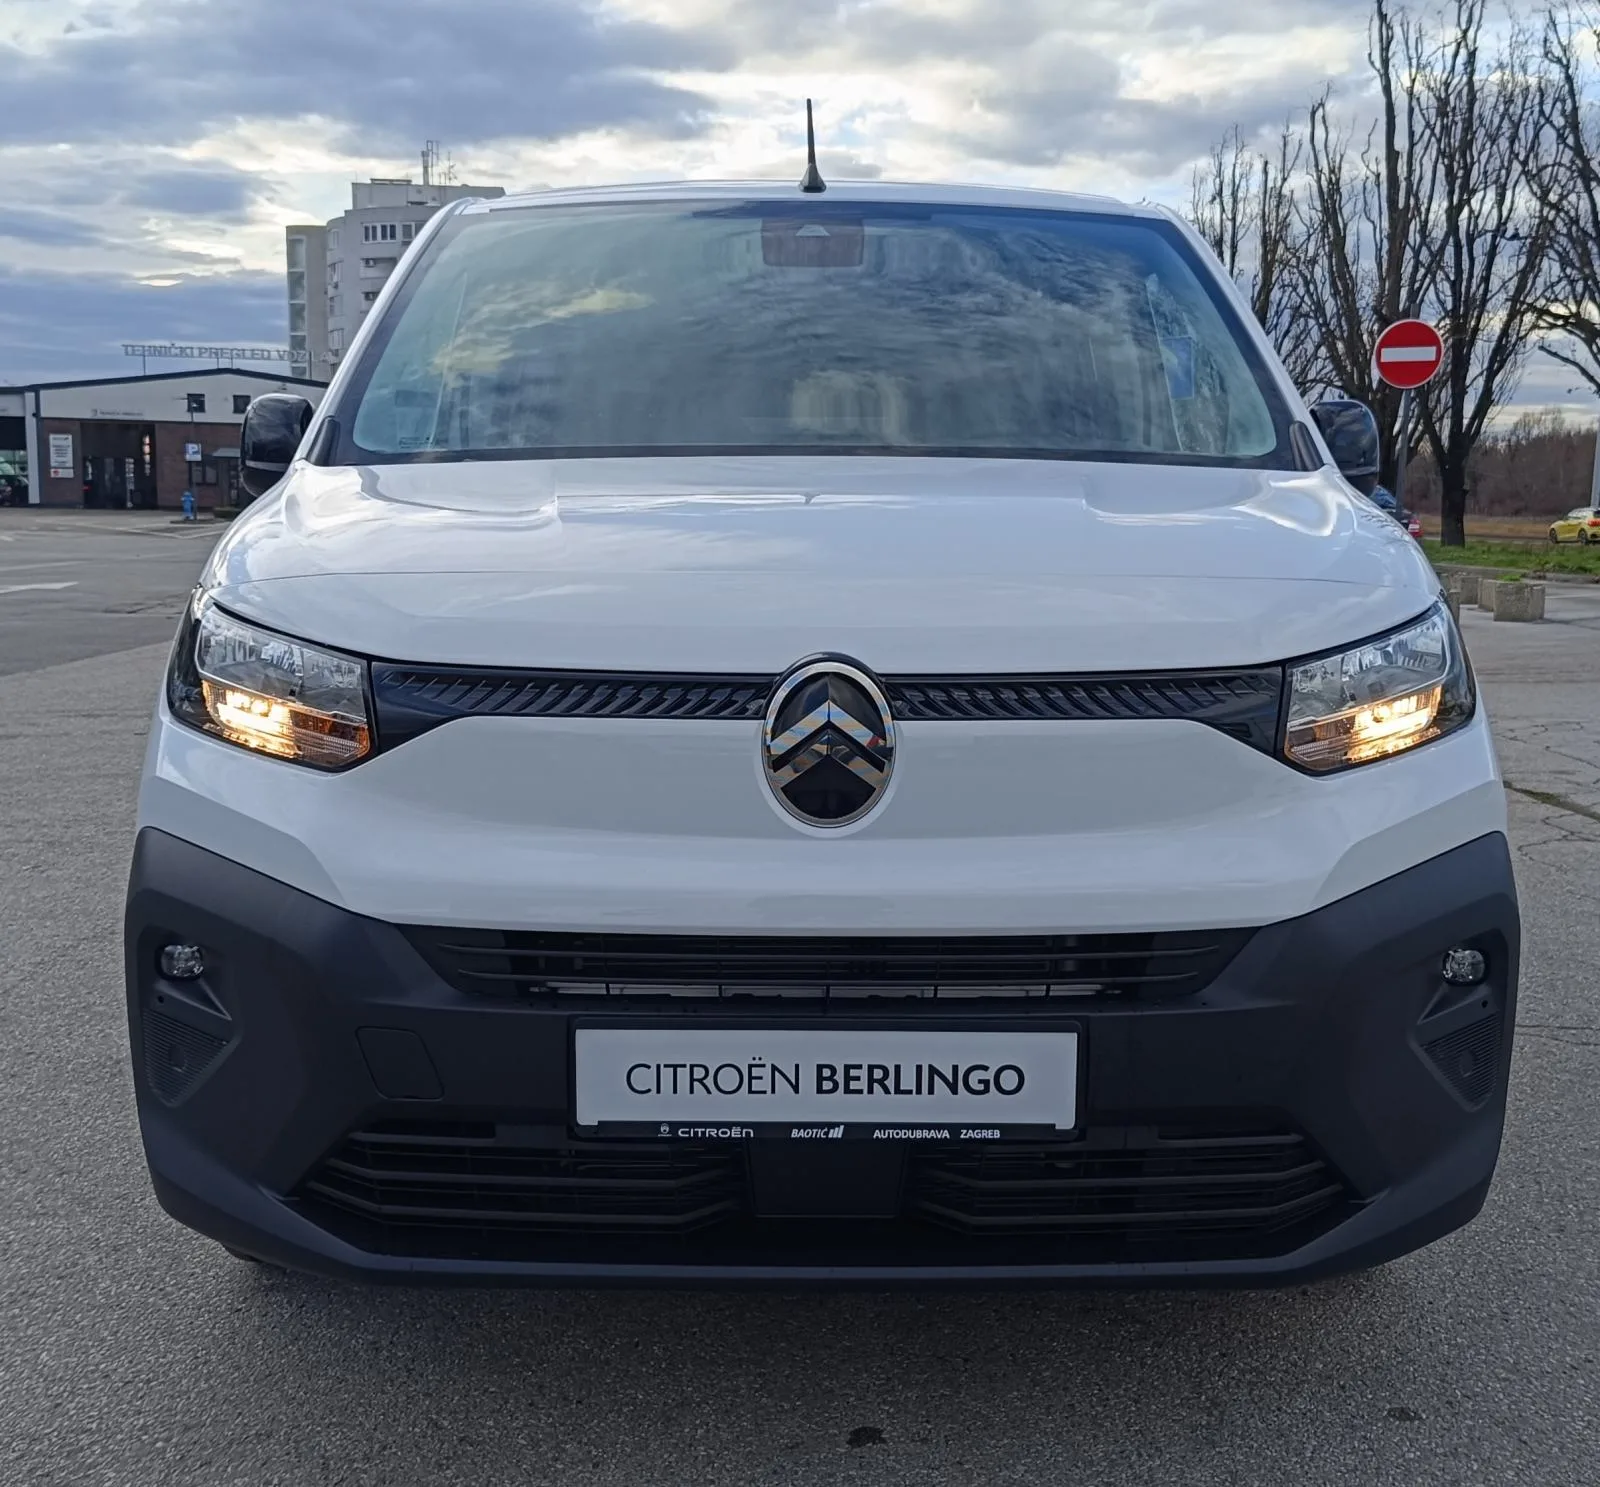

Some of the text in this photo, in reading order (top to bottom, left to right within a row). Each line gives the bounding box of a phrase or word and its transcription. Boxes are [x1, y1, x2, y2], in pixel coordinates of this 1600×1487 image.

[122, 343, 195, 359] TEHNIČKI
[198, 347, 271, 361] PREGLED
[626, 1057, 1025, 1096] CITROËN BERLINGO
[873, 1129, 1000, 1139] AUTODUBRAVA ZAGREB
